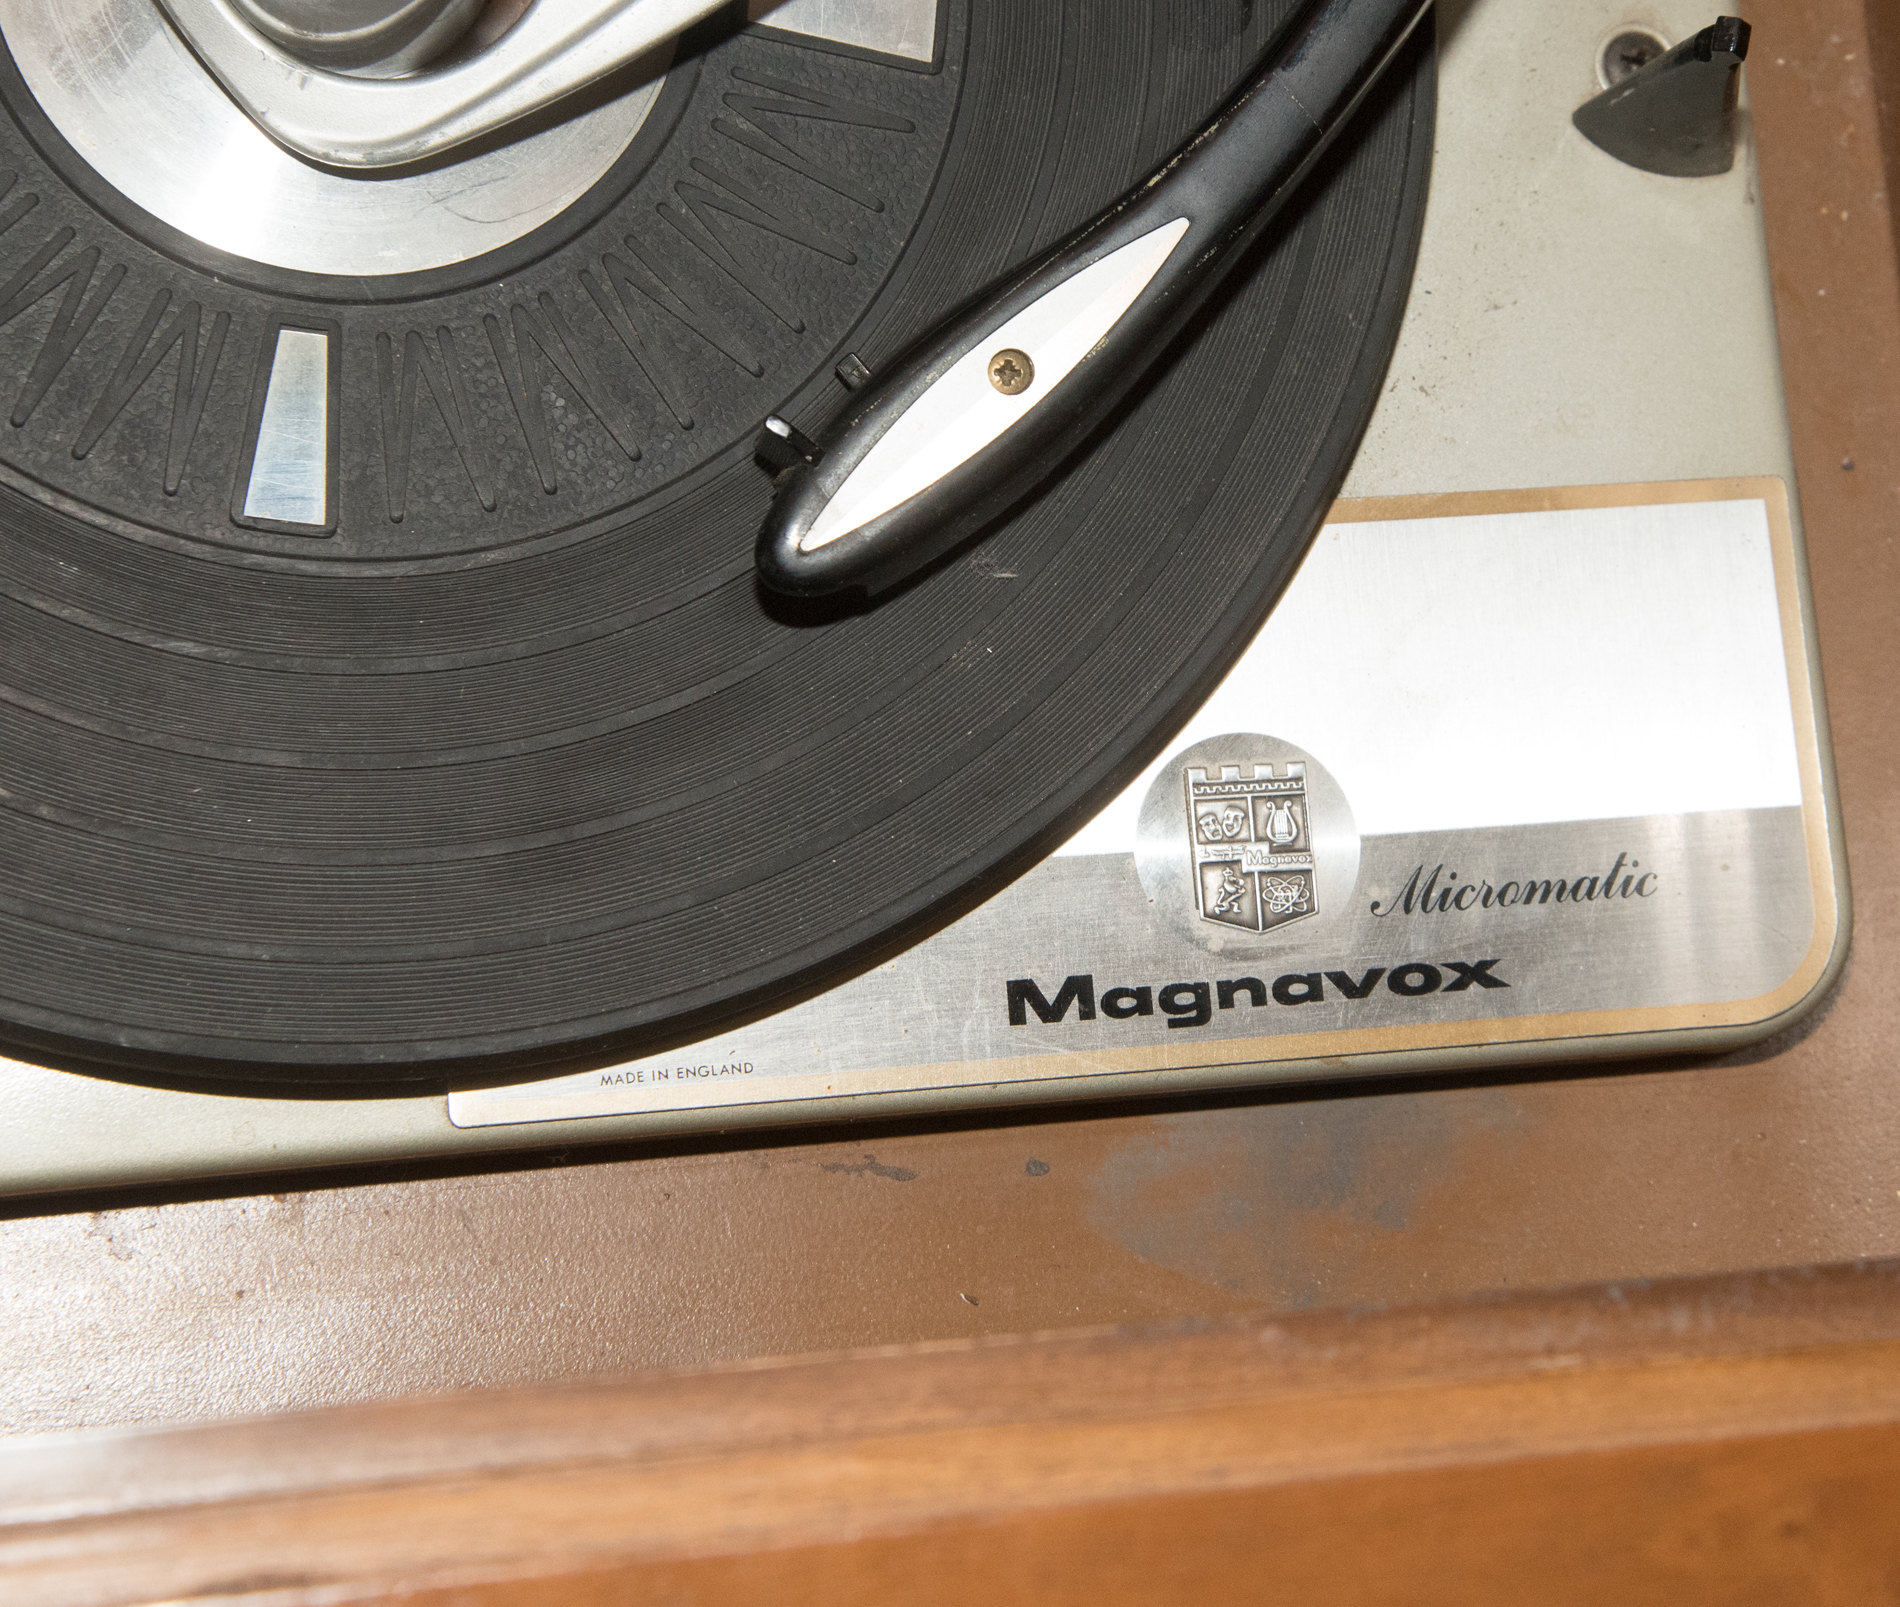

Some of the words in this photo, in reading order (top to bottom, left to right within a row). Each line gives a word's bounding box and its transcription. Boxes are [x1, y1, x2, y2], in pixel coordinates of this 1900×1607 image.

[1246, 850, 1313, 867] Magnavox
[1370, 851, 1658, 917] Micromatic
[1006, 958, 1511, 1029] Magnavox
[600, 1070, 644, 1087] MADE
[652, 1068, 669, 1081] IN
[676, 1062, 754, 1079] ENGLAND
